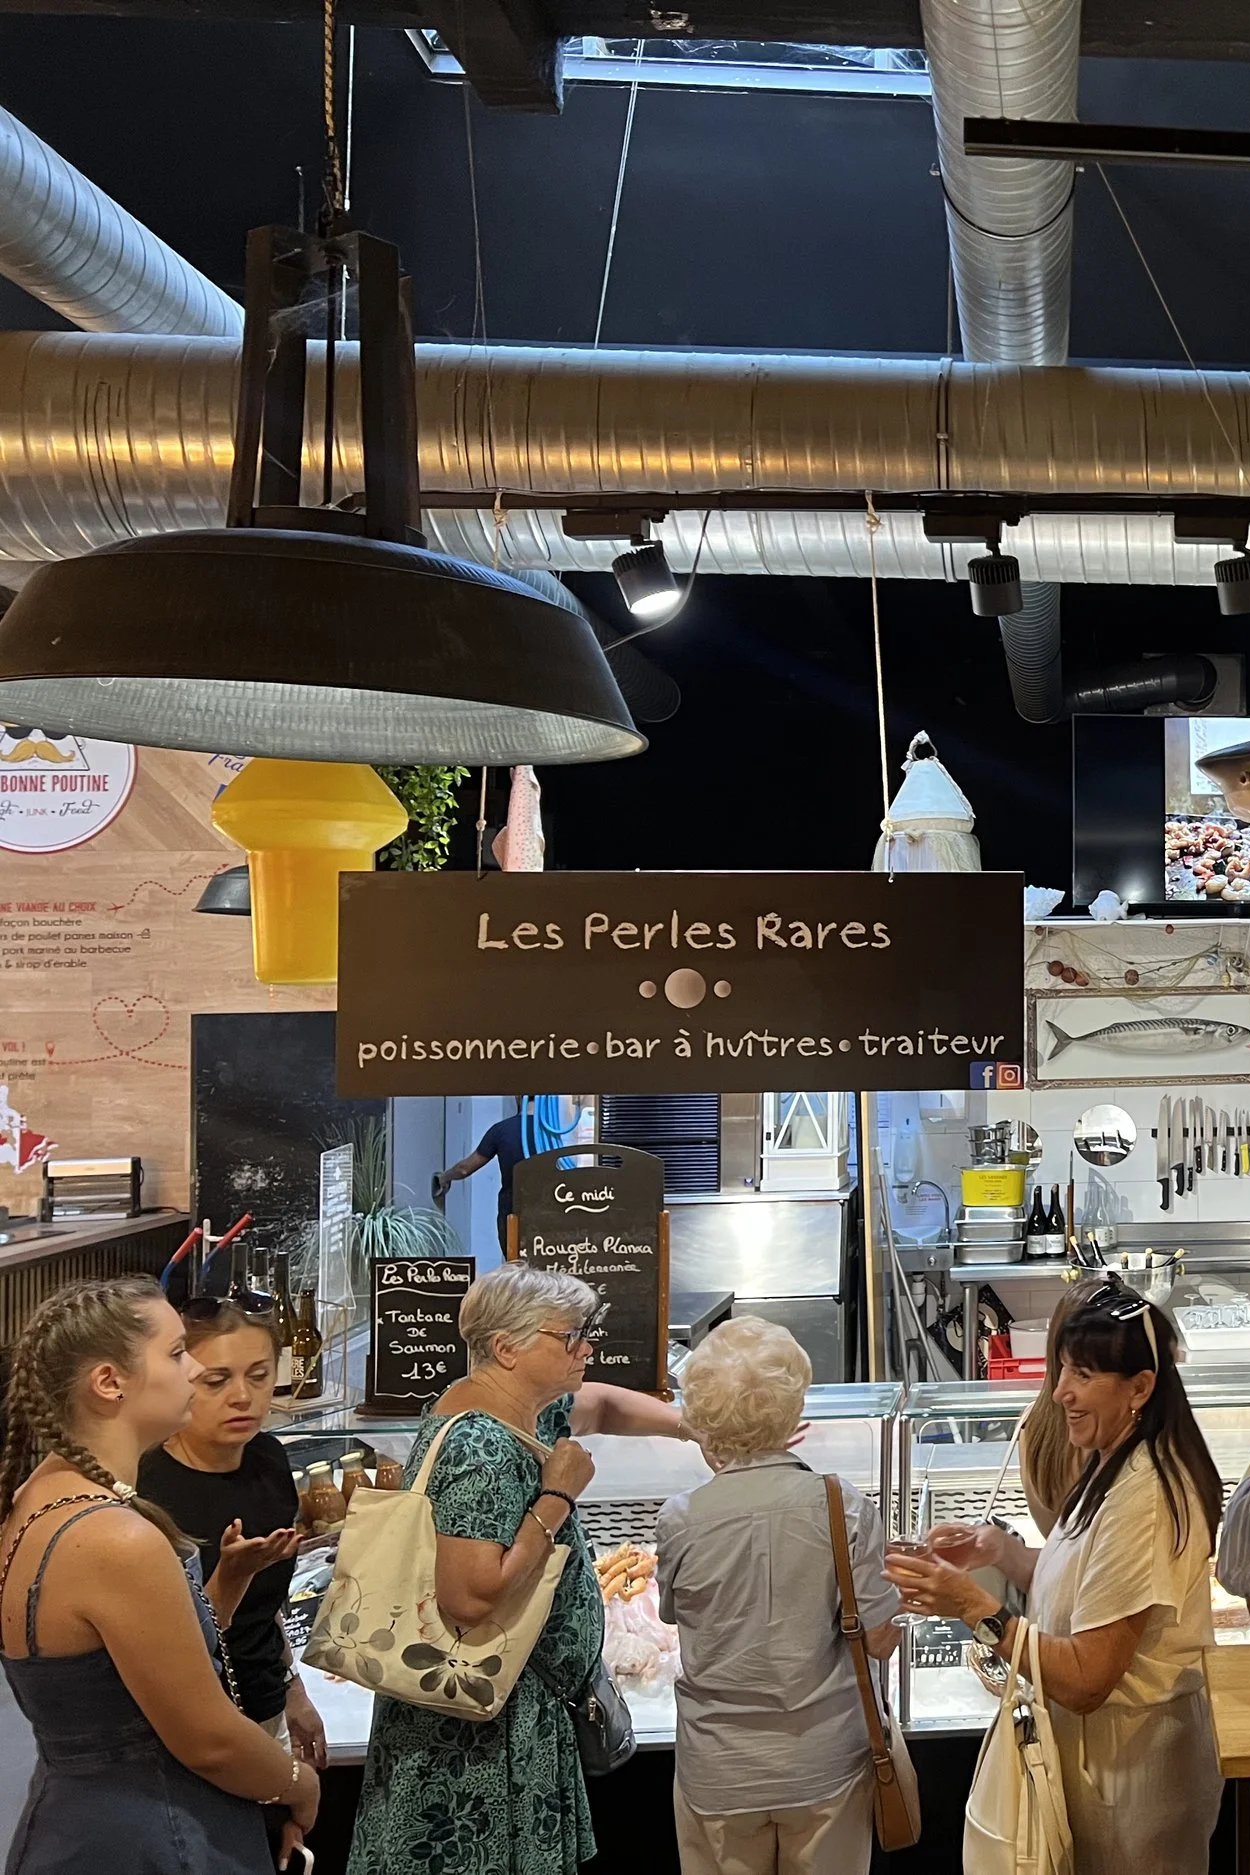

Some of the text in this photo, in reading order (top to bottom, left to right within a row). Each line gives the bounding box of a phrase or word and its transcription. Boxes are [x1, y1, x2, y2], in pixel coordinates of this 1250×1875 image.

[1, 774, 109, 792] BONNE POUTINE
[59, 799, 101, 817] Food
[53, 902, 66, 912] AU
[69, 902, 97, 912] CHOIX
[32, 917, 82, 926] bouchère
[11, 932, 25, 941] de
[28, 932, 61, 942] poulet
[98, 932, 133, 940] maison
[477, 909, 892, 951] Les Perles Rares
[80, 945, 131, 954] barbecue
[358, 1028, 1004, 1068] poissonnerie bar à huîtres traiteur
[554, 1183, 615, 1202] Ce midi
[533, 1236, 597, 1263] Rougets
[381, 1264, 404, 1284] Les
[385, 1309, 453, 1323] Tartare
[406, 1327, 427, 1337] DE
[389, 1340, 456, 1355] Saumon
[600, 1351, 630, 1364] terre
[401, 1361, 447, 1380] 13€
